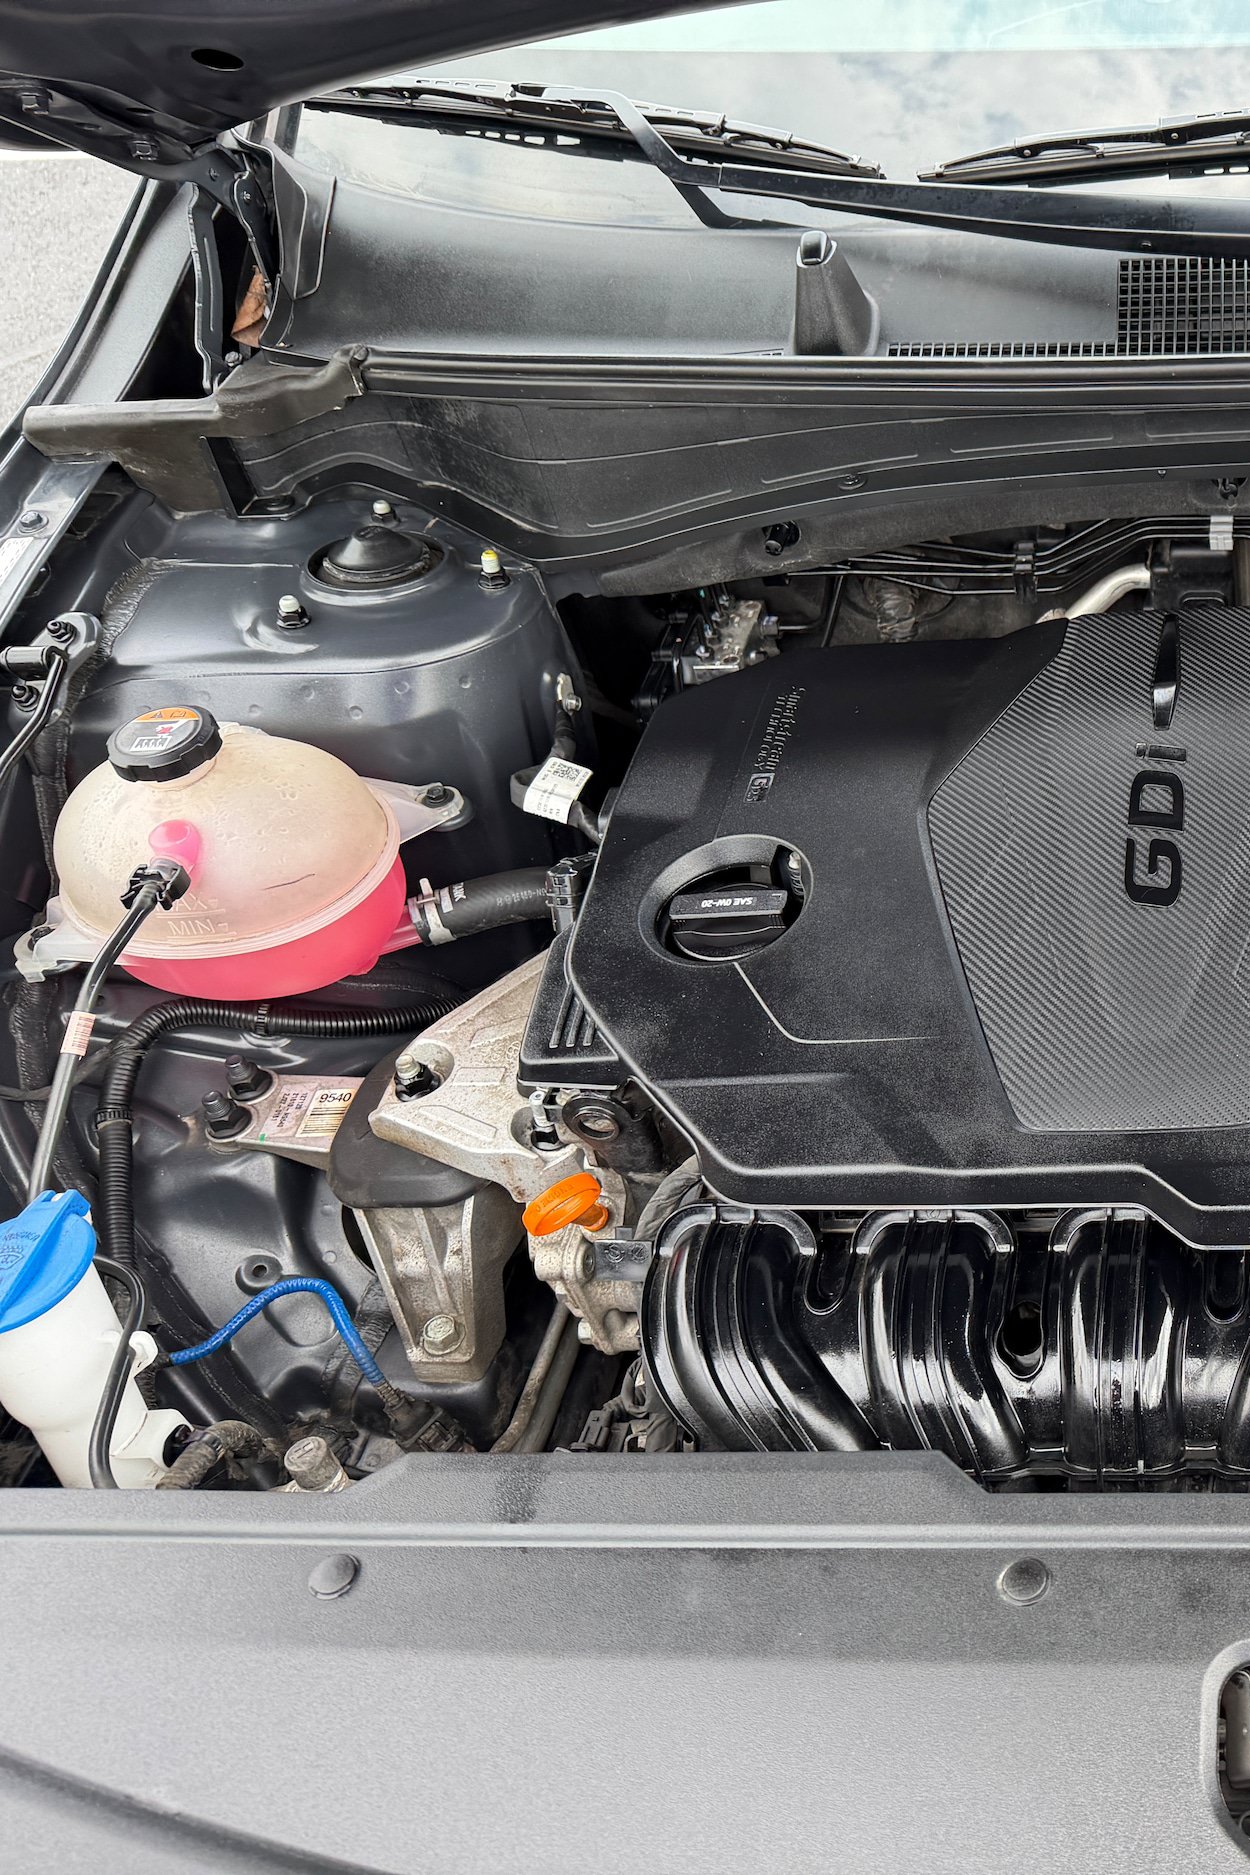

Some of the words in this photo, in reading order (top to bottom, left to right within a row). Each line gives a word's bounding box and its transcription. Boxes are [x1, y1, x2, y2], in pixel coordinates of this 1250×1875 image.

[1123, 741, 1187, 909] GDi
[156, 892, 208, 911] AX
[701, 898, 732, 908] 0W-20
[733, 896, 755, 906] SAE
[167, 918, 216, 936] MIN
[319, 1092, 352, 1103] 9540
